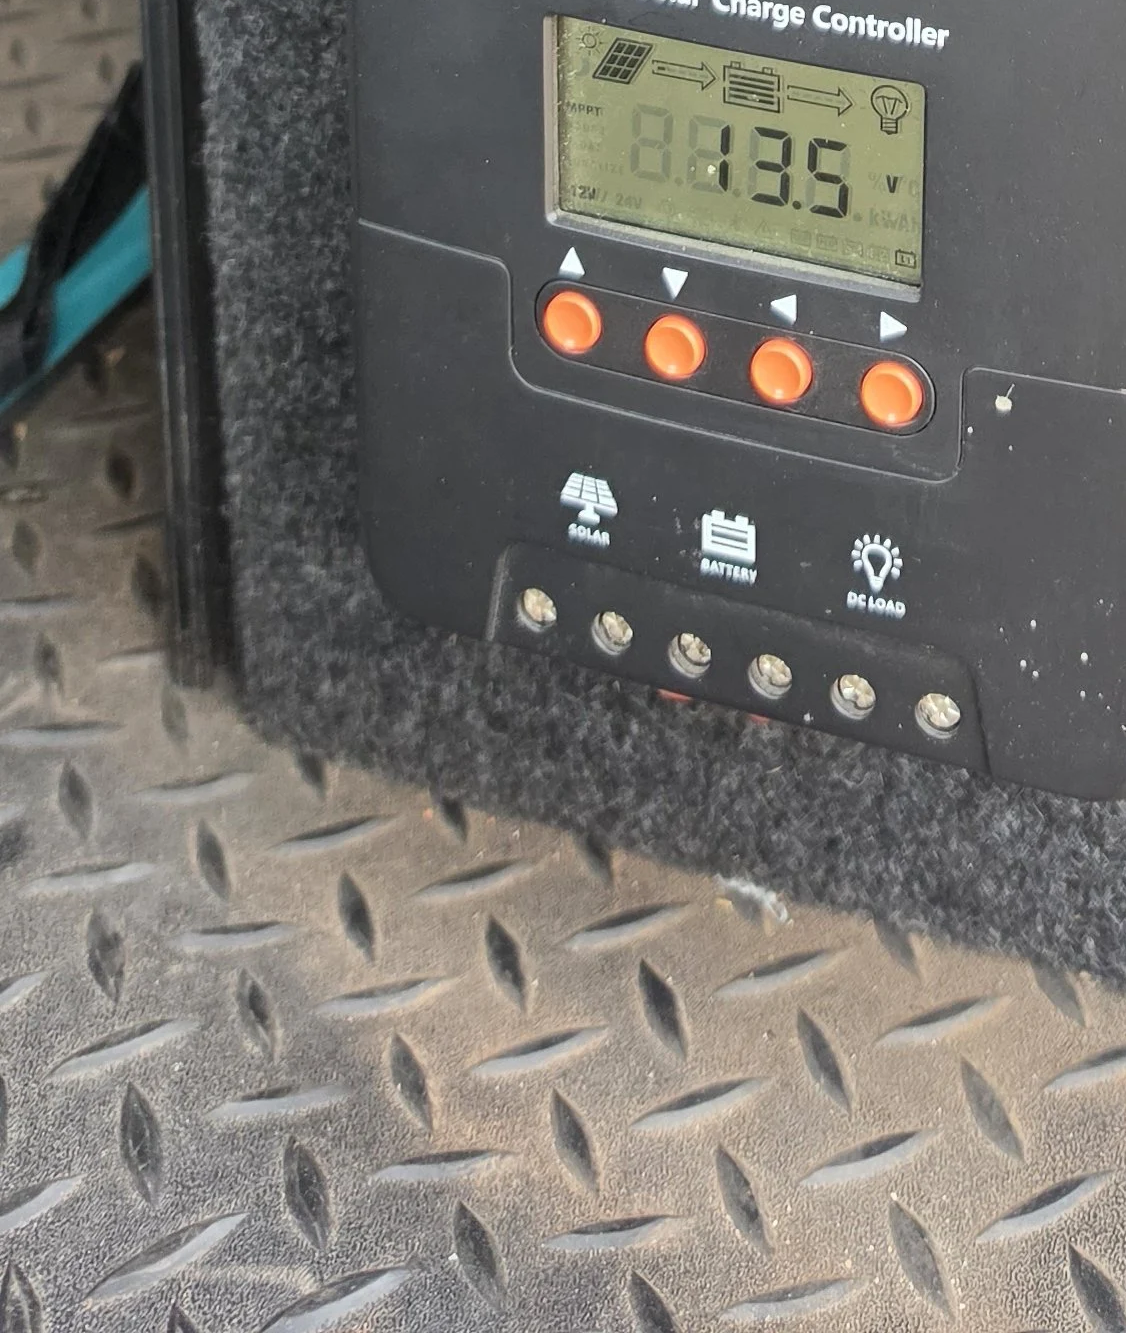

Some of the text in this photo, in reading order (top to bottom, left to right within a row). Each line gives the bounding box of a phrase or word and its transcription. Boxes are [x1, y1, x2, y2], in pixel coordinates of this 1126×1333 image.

[812, 5, 950, 51] Controller
[717, 123, 850, 219] 13.5
[568, 523, 611, 548] SOLAR
[701, 558, 758, 585] BATTERY
[847, 591, 907, 619] DC LOAD
